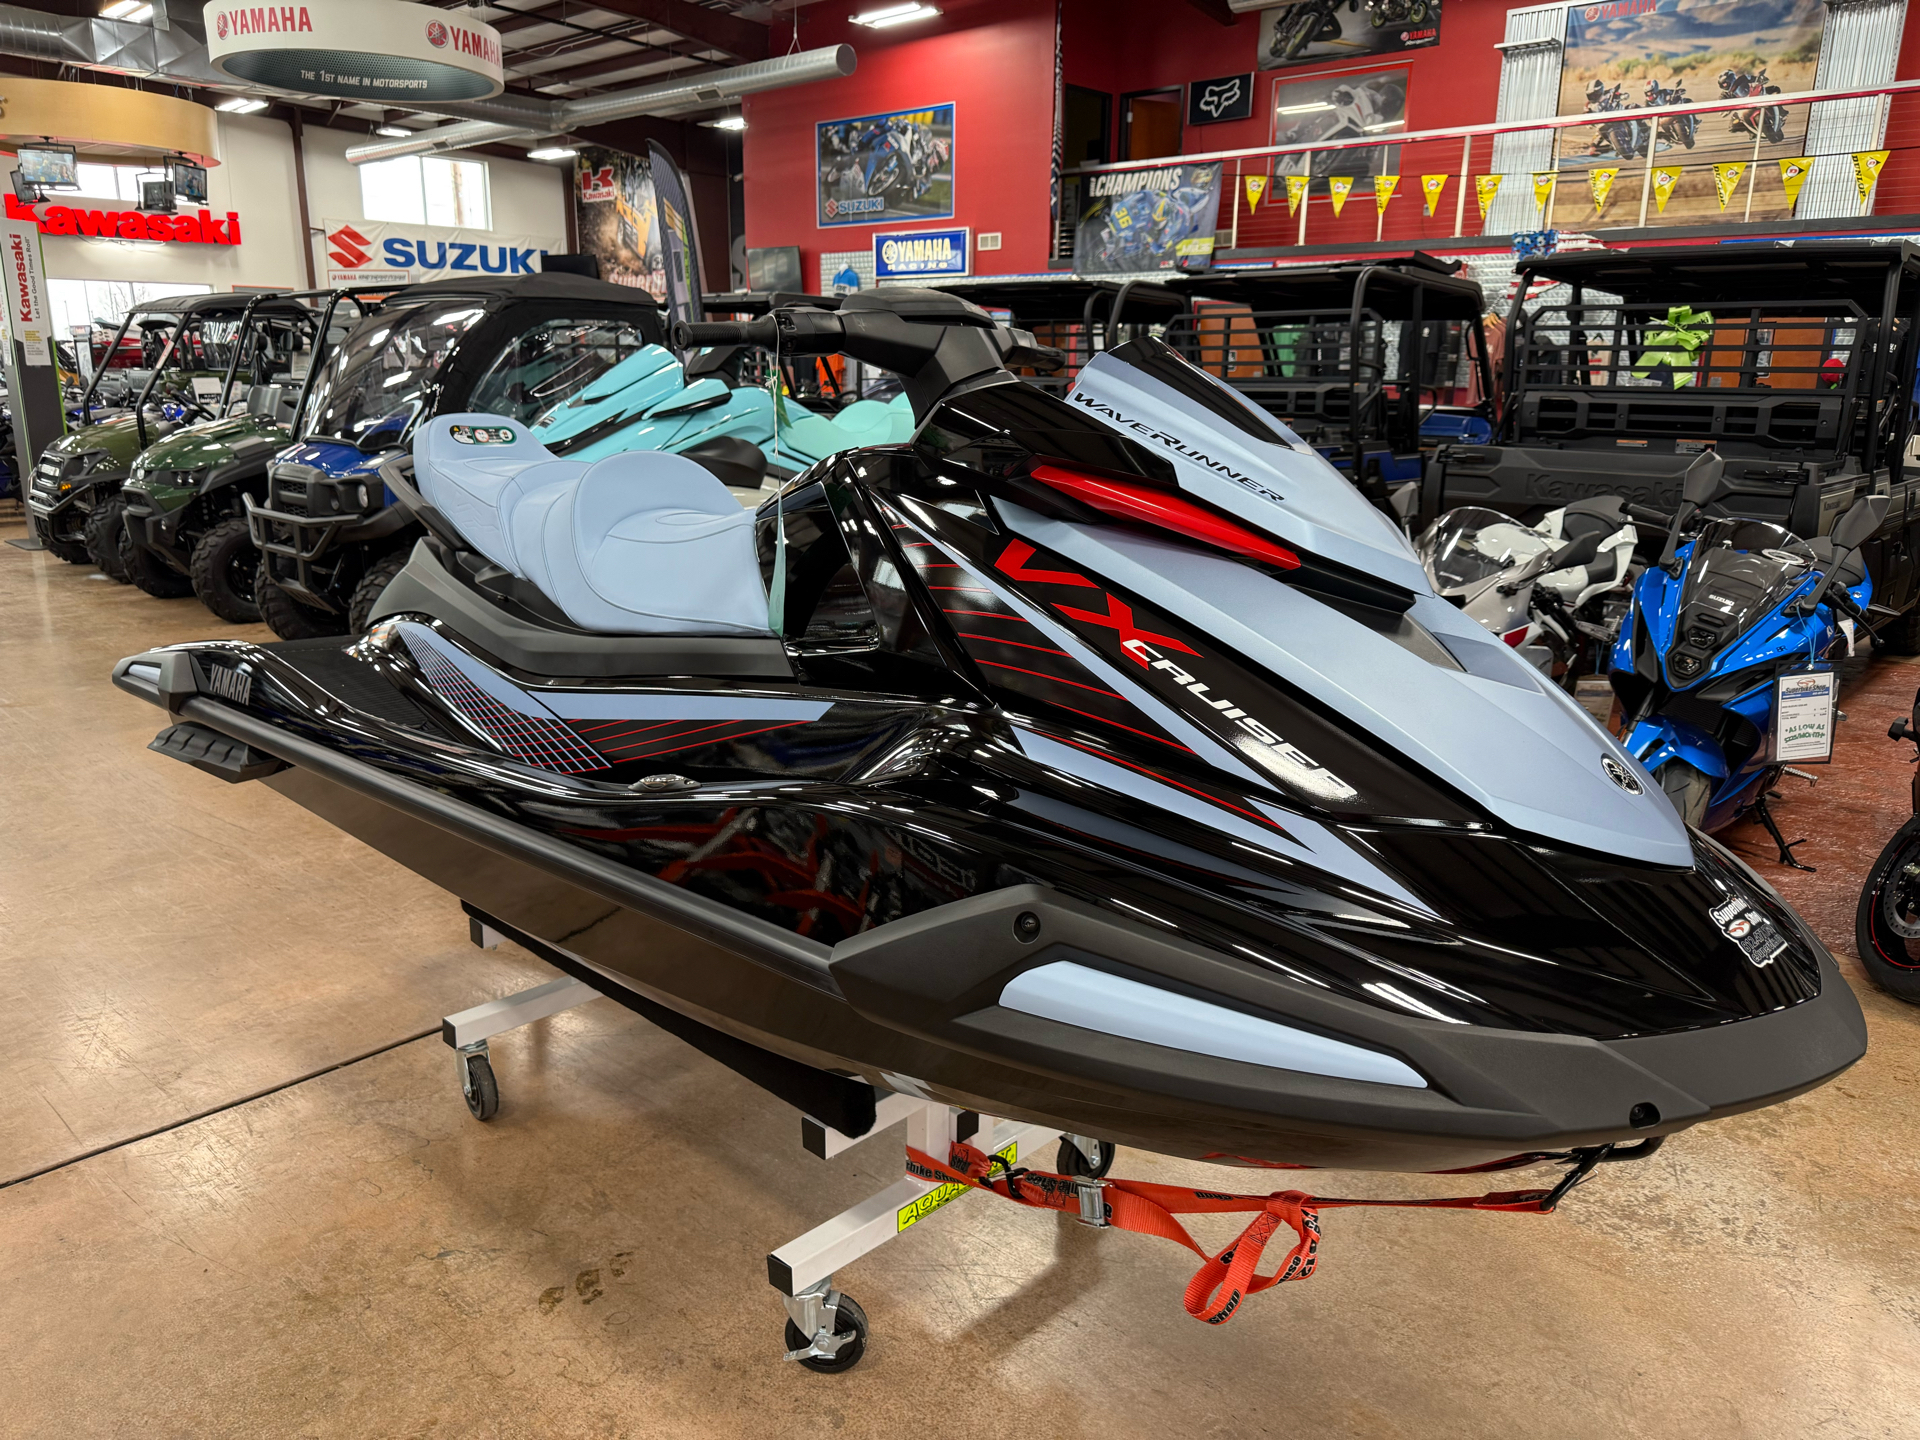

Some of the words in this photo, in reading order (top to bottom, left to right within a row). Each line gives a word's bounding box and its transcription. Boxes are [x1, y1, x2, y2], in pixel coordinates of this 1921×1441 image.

[229, 6, 313, 36] YAMAHA
[1601, 0, 1657, 19] YAMAHA
[450, 25, 501, 66] YAMAHA
[1409, 28, 1437, 39] YAMAHA
[301, 69, 315, 81] THE
[319, 70, 335, 83] 1ST
[337, 75, 360, 87] NAME
[362, 77, 370, 87] IN
[373, 78, 428, 90] MOTORSPORTS
[1095, 167, 1183, 197] CHAMPIONS
[1590, 170, 1602, 207] DUNLOP
[1714, 165, 1726, 206] DUNLOP
[1852, 155, 1866, 197] DUNLOP
[583, 189, 615, 200] Kawasaki
[839, 197, 885, 213] SUZUKI
[4, 193, 241, 245] Kawasaki
[1114, 207, 1133, 229] 36
[383, 237, 549, 274] SUZUK
[897, 237, 951, 262] YAMAHA
[9, 233, 33, 322] Kawasaki
[888, 261, 948, 271] RACING
[30, 275, 38, 294] Good
[1074, 392, 1285, 502] WAVERUNNER
[1526, 473, 1684, 507] Kawasaki
[1708, 594, 1735, 606] SUZUKI
[994, 538, 1204, 671] VX
[1122, 639, 1358, 799] CRUISER
[210, 663, 252, 707] YAMAHA
[1798, 723, 1815, 731] LOW
[902, 1182, 960, 1225] AQUA
[1208, 1288, 1241, 1324] Shop
